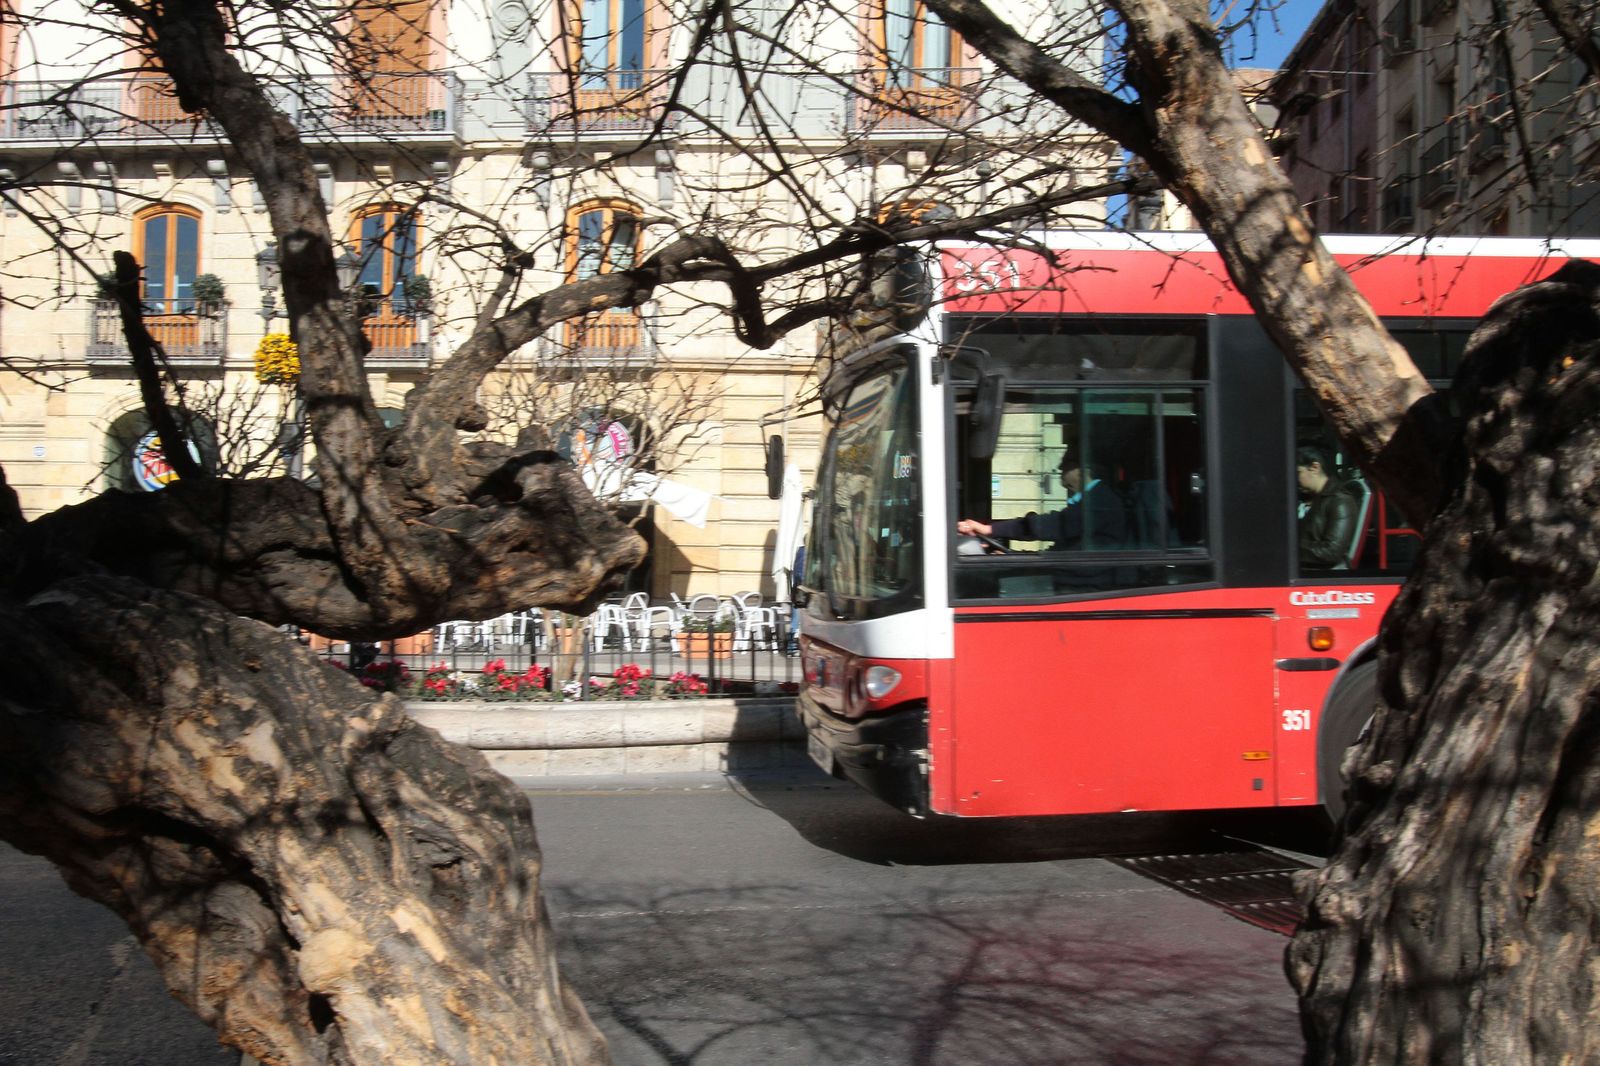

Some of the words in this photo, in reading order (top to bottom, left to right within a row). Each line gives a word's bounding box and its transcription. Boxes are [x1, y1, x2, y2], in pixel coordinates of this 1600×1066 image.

[953, 260, 1019, 292] 351
[1289, 590, 1375, 606] CityClass
[1282, 709, 1311, 731] 351
